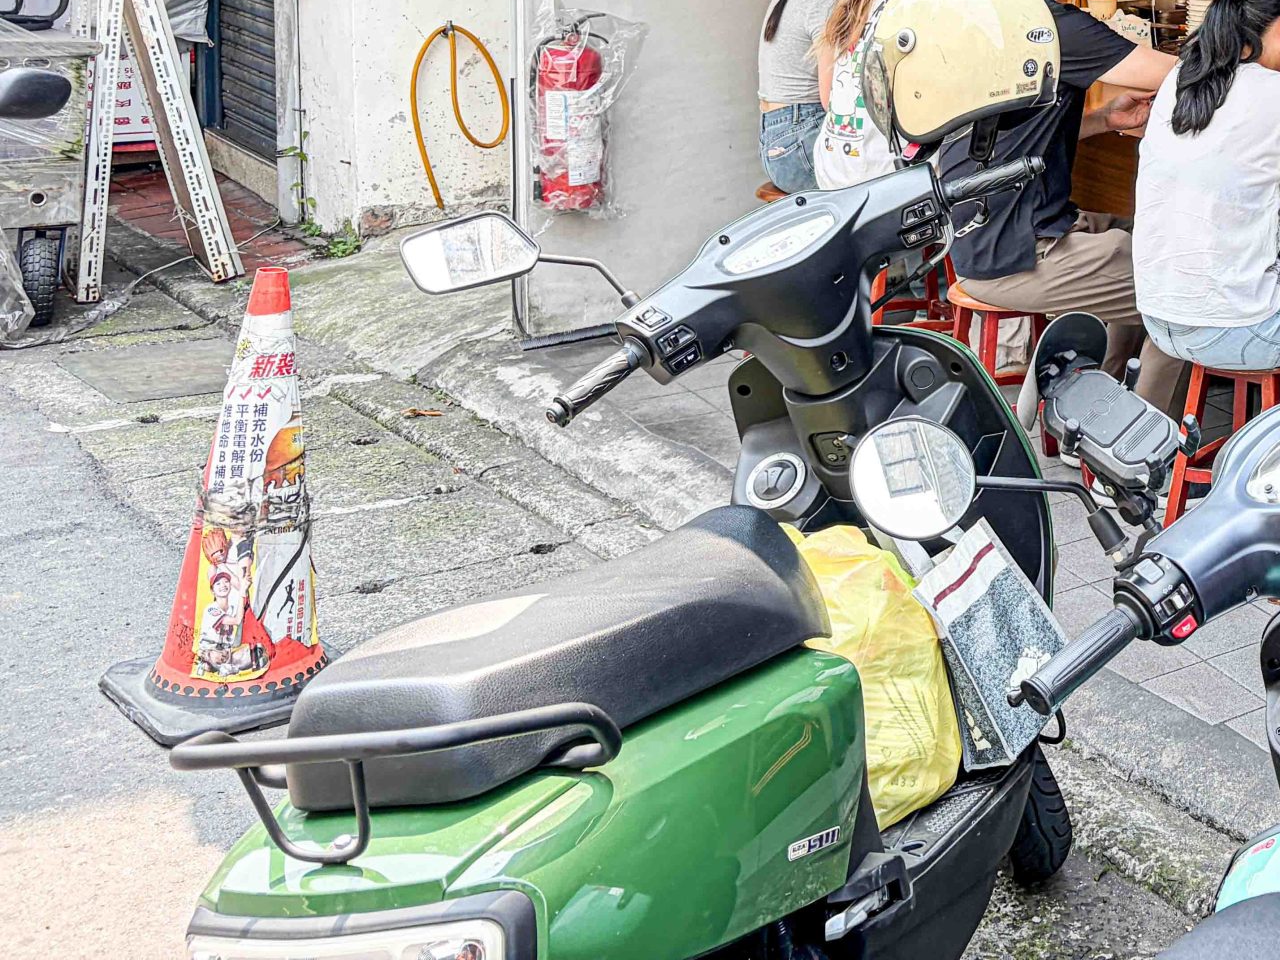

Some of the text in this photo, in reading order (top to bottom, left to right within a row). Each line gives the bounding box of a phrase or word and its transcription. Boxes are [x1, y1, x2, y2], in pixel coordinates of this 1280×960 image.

[249, 351, 298, 380] 新裝
[230, 404, 250, 480] 平衡電解質
[250, 403, 269, 464] 補充水份
